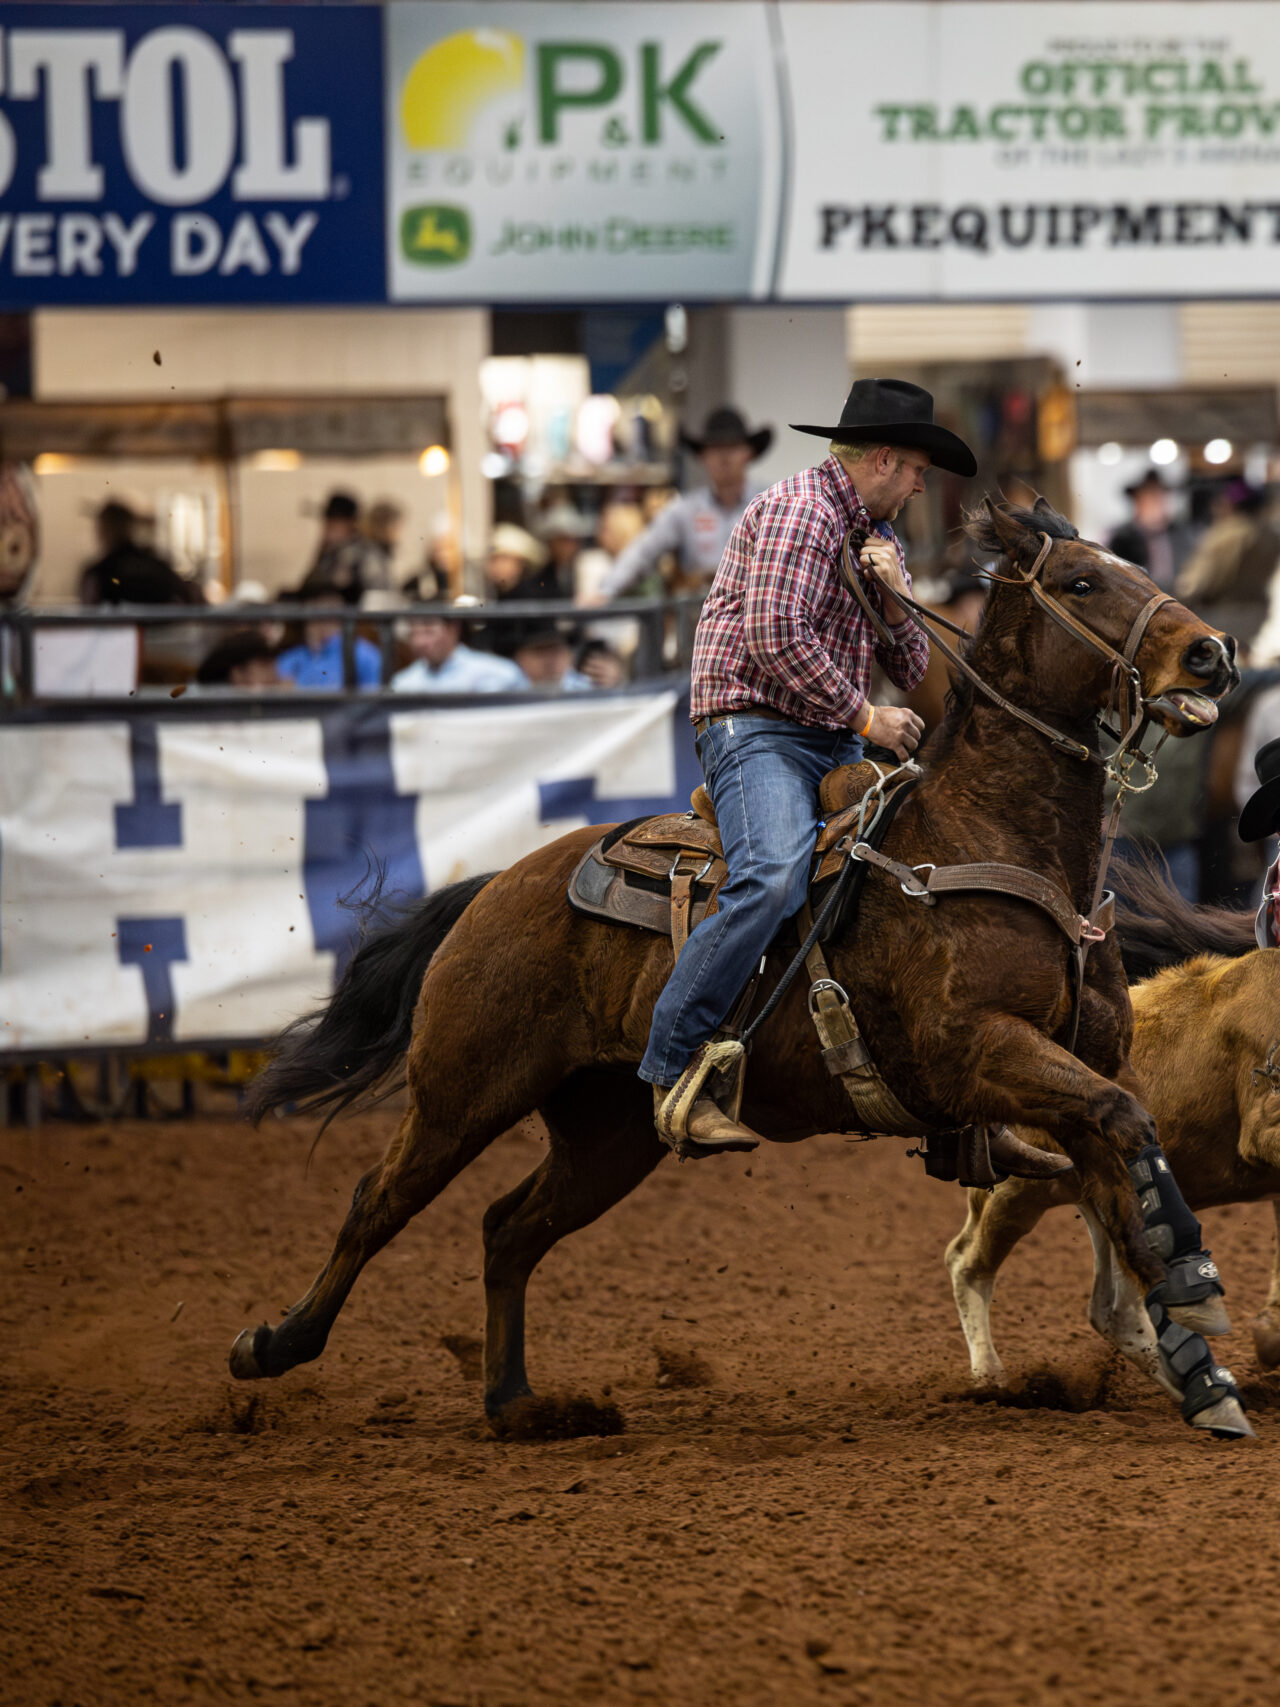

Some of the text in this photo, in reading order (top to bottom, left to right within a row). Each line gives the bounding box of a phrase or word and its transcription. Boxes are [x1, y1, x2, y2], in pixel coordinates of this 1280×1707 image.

[535, 40, 724, 147] P&K
[1018, 58, 1263, 98] OFFICIAL
[0, 25, 330, 206] TOL
[874, 103, 1129, 143] TRACTOR
[171, 212, 318, 276] DAY
